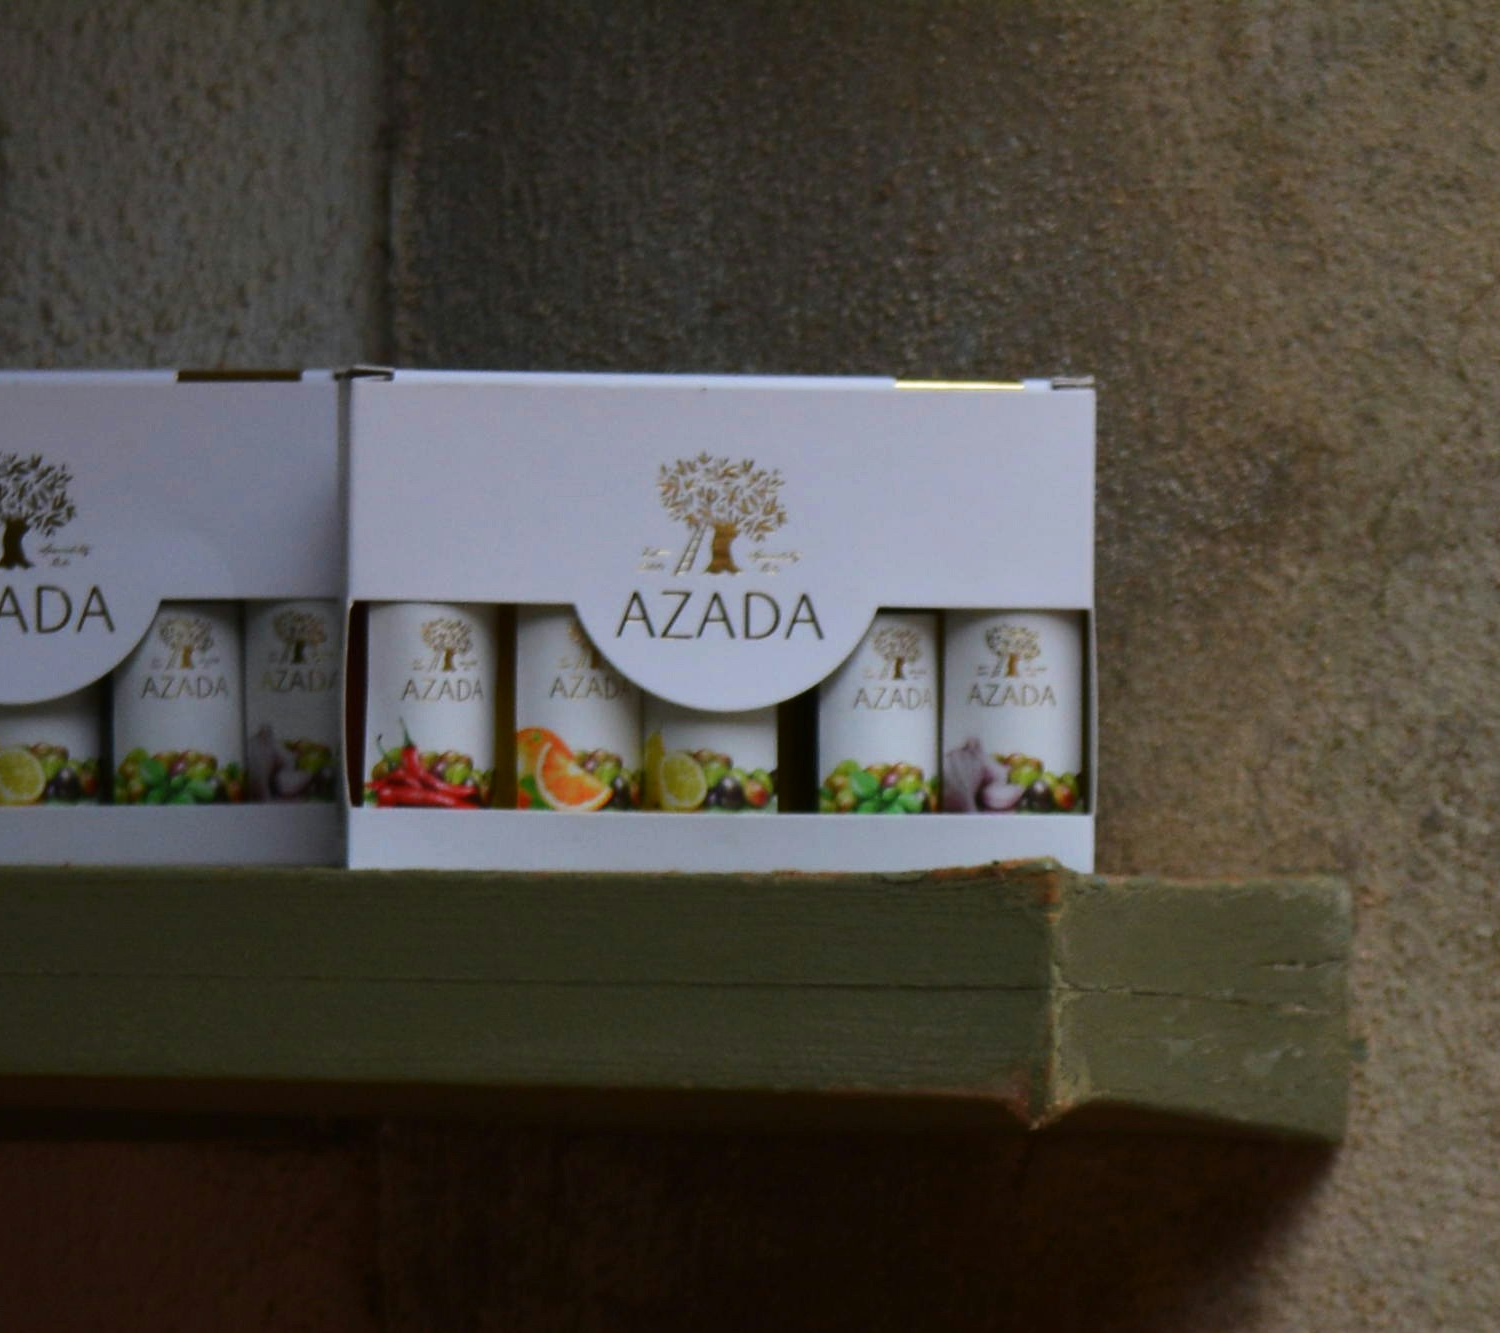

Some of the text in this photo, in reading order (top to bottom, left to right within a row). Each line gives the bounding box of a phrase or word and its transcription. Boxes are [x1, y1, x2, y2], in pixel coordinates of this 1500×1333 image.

[615, 588, 825, 643] AZADA
[140, 674, 229, 699] AZADA
[401, 678, 485, 702] AZADA
[967, 681, 1057, 708] AZADA
